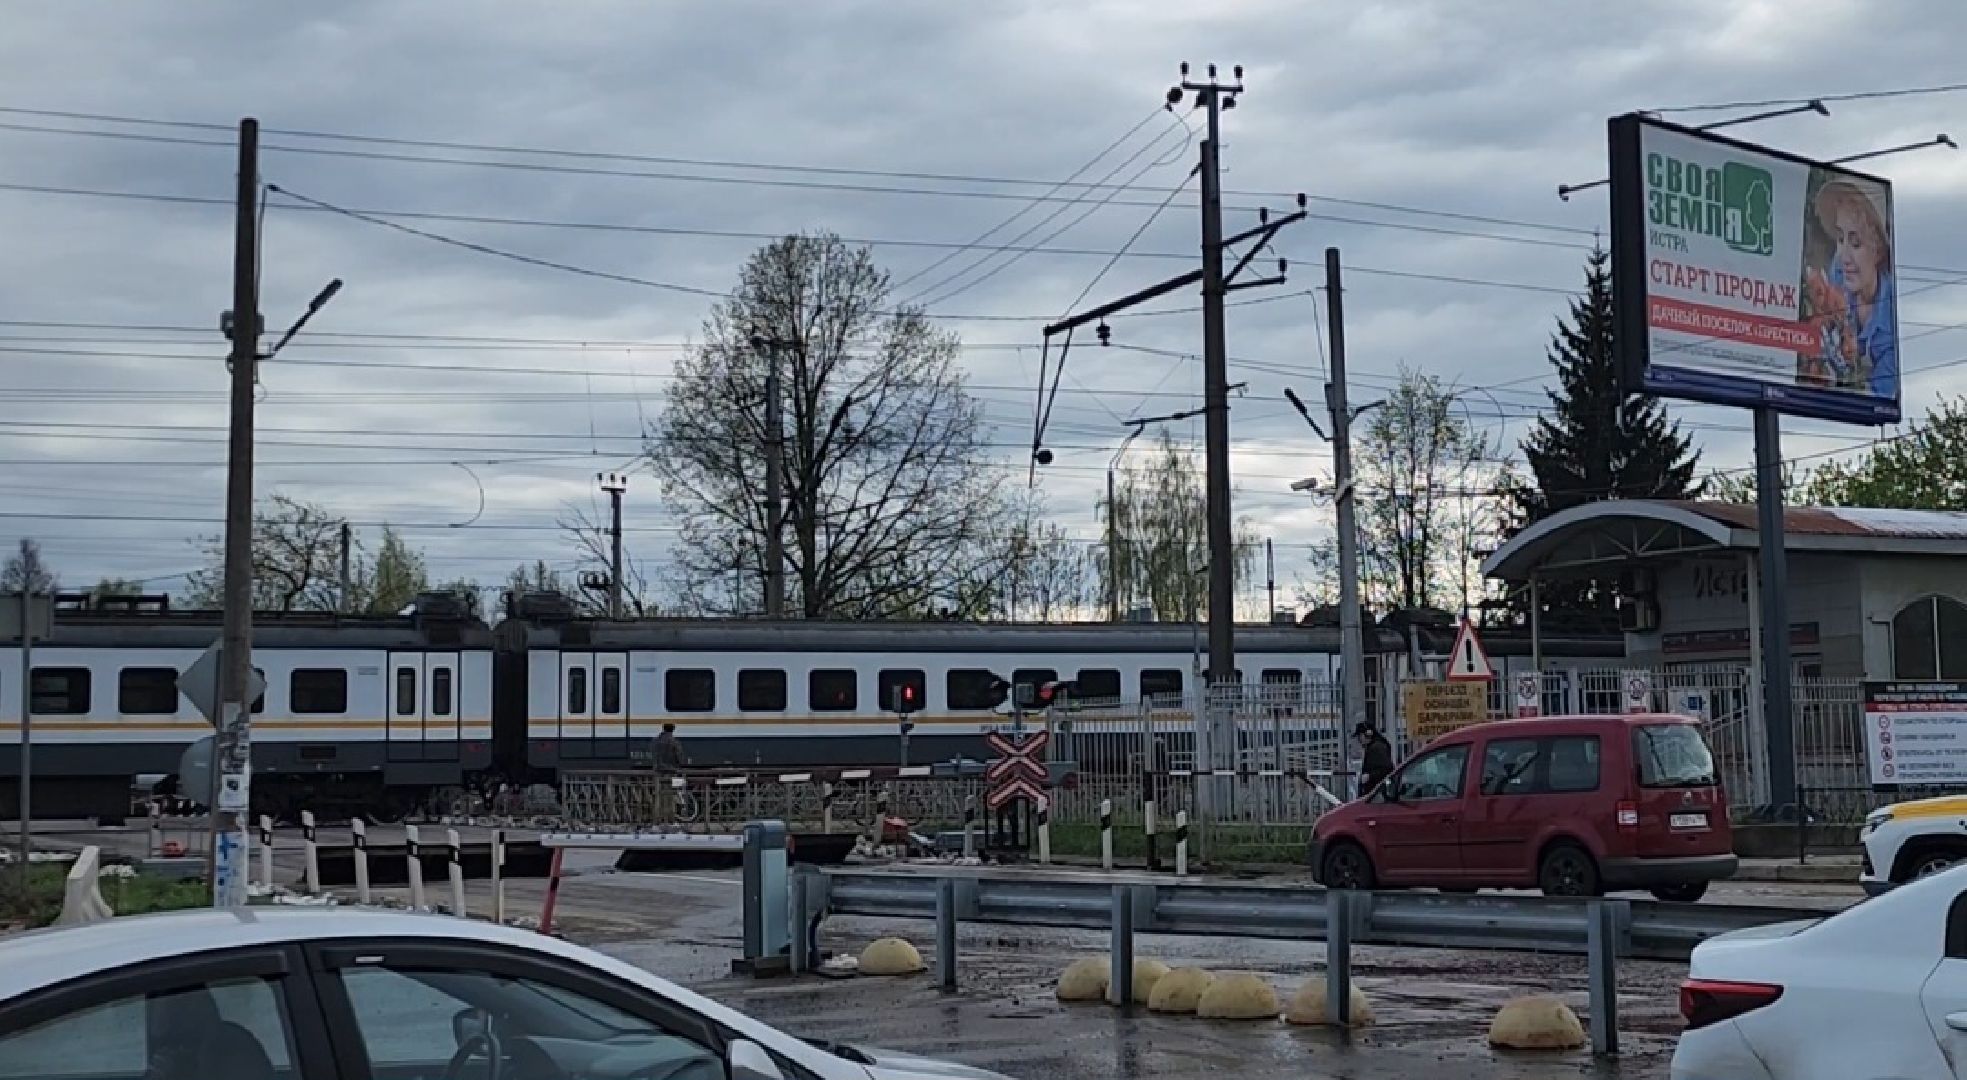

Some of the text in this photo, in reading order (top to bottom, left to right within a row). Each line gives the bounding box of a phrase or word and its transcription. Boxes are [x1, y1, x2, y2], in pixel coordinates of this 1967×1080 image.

[1647, 152, 1721, 203] СВОЯ
[1648, 190, 1742, 243] ЗЕМЛЯ
[1650, 232, 1689, 254] ИСТРА
[1650, 259, 1796, 309] СТАРТ ПРОДАЖ
[1652, 303, 1700, 328] ДАЧНЫЙ
